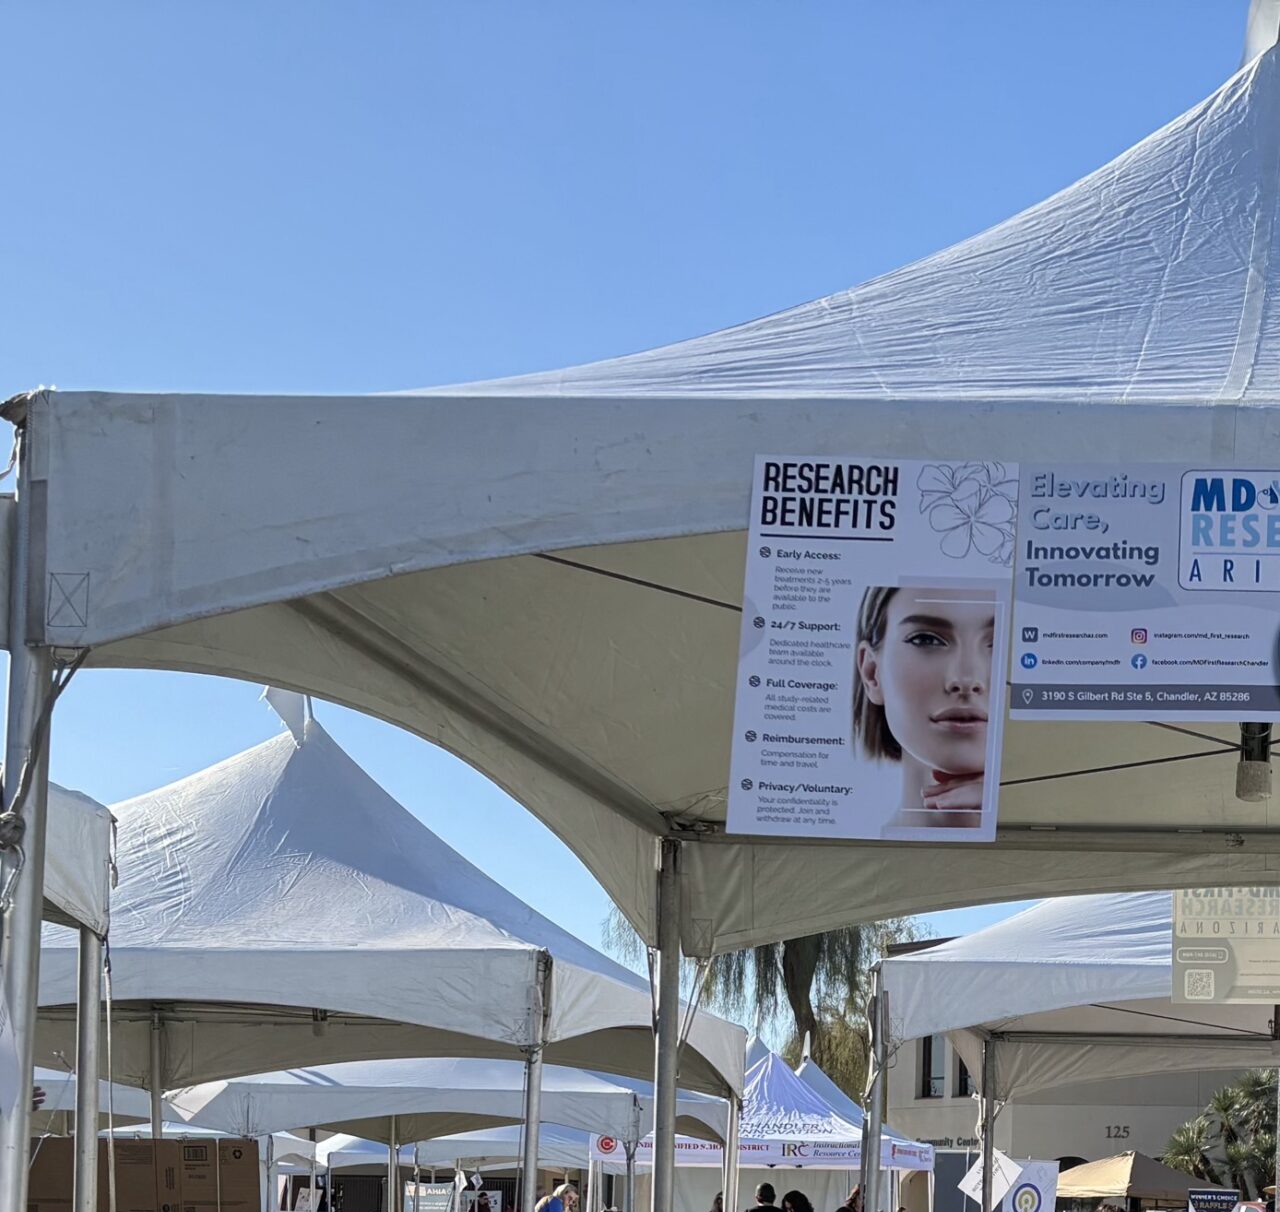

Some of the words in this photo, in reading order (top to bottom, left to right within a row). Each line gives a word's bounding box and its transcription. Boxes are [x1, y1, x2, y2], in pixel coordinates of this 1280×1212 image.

[763, 462, 899, 496] RESEARCH
[1030, 472, 1165, 503] Elevating
[1191, 478, 1256, 512] MD
[760, 496, 895, 530] BENEFITS
[1031, 506, 1109, 534] Care,
[1026, 540, 1160, 565] Innovating
[1026, 567, 1155, 587] Tomorrow
[1105, 1126, 1130, 1139] 125
